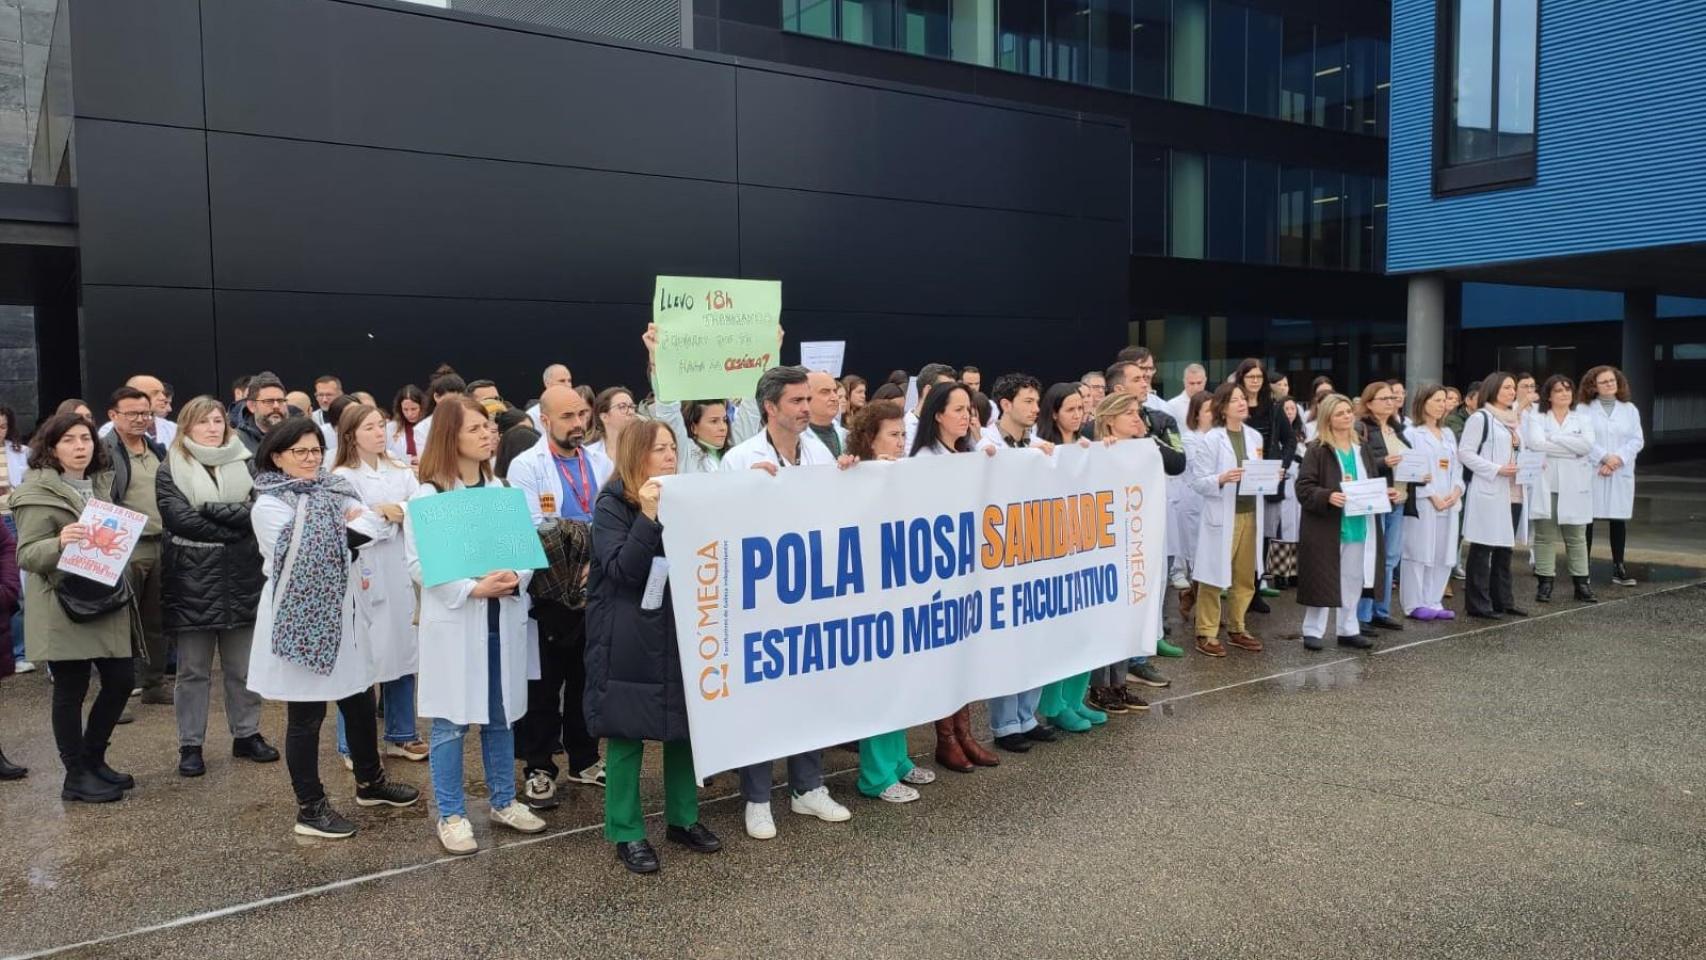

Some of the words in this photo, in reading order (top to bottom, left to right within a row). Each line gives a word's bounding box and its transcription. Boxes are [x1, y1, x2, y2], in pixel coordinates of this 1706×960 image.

[660, 287, 695, 312] LLEVO
[705, 289, 733, 311] 18h
[741, 525, 865, 610] POLA
[880, 511, 975, 590] NOSA
[981, 490, 1117, 570] SANIDADE
[744, 612, 895, 684] ESTATUTO
[902, 589, 983, 655] MÉDICO
[990, 586, 1006, 631] E
[1012, 563, 1119, 628] FACULTATIVO
